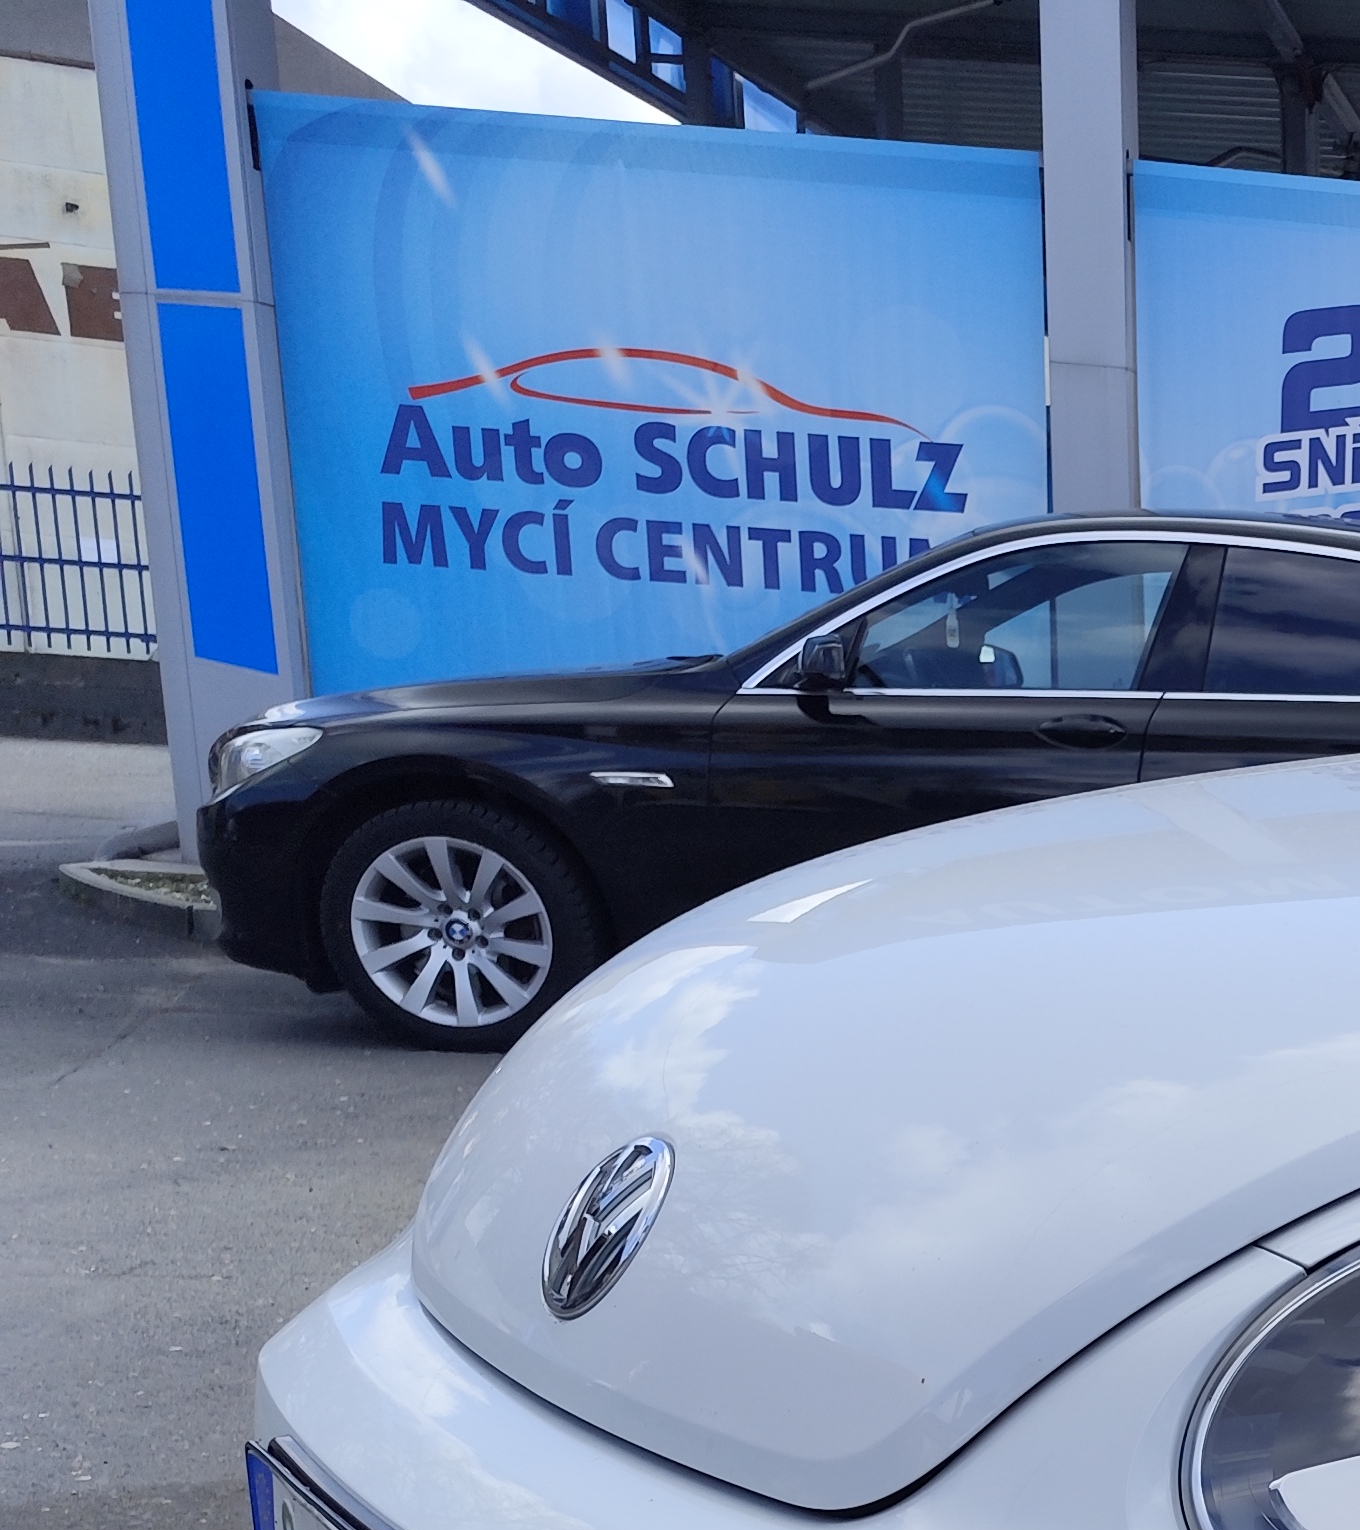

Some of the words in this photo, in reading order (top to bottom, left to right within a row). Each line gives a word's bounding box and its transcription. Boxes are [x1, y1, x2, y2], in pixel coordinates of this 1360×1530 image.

[380, 403, 603, 488] Auto
[632, 421, 969, 513] SCHULZ
[381, 498, 575, 576] MYCÍ
